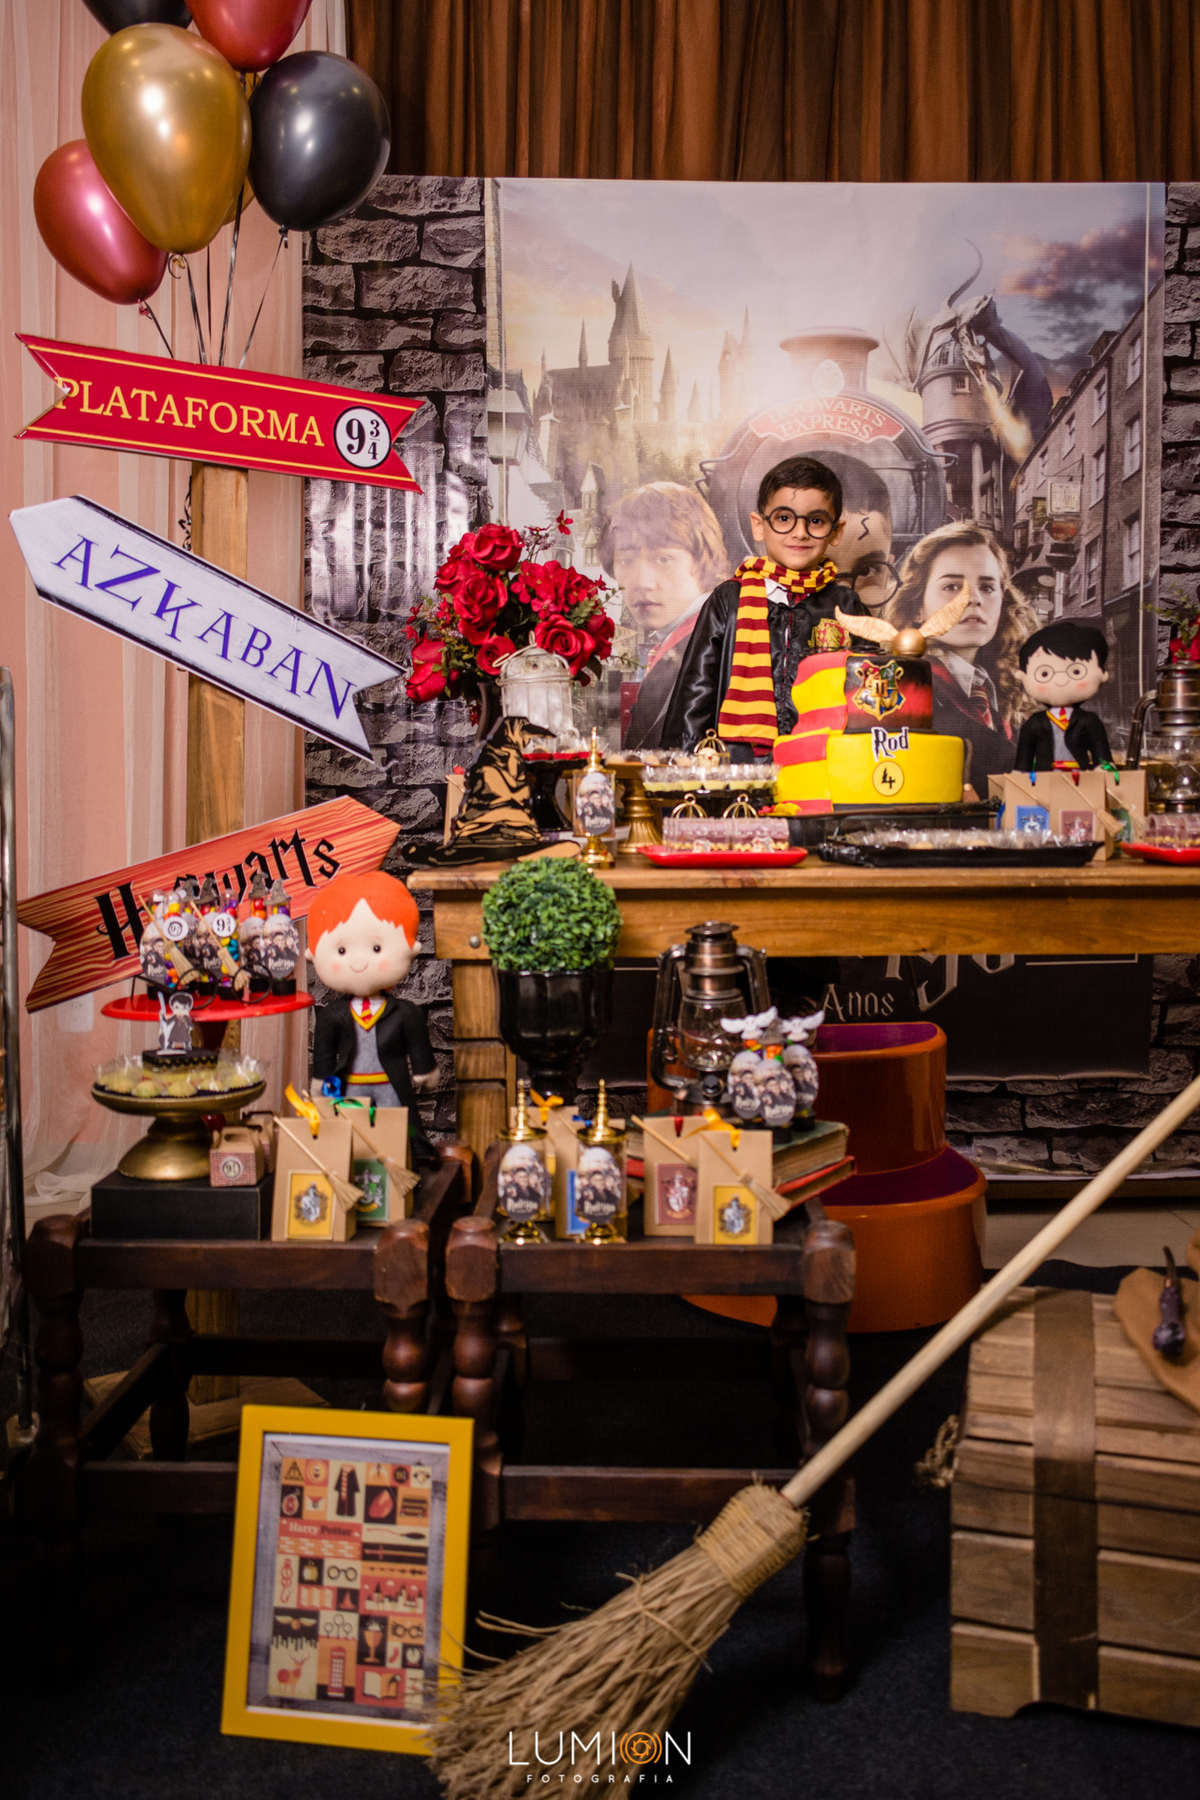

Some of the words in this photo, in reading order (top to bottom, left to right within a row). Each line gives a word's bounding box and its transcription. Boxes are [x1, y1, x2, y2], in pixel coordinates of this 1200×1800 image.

[54, 376, 325, 448] PLATAFORMA
[768, 397, 886, 428] HOGWARTS
[780, 414, 873, 440] EXPRESS
[51, 534, 358, 721] AZKABAN
[871, 727, 910, 761] Rod
[881, 767, 896, 790] 4
[268, 957, 295, 971] Rodrigo
[822, 983, 896, 1023] Anos
[288, 1522, 320, 1537] Harry
[321, 1525, 353, 1537] Potter
